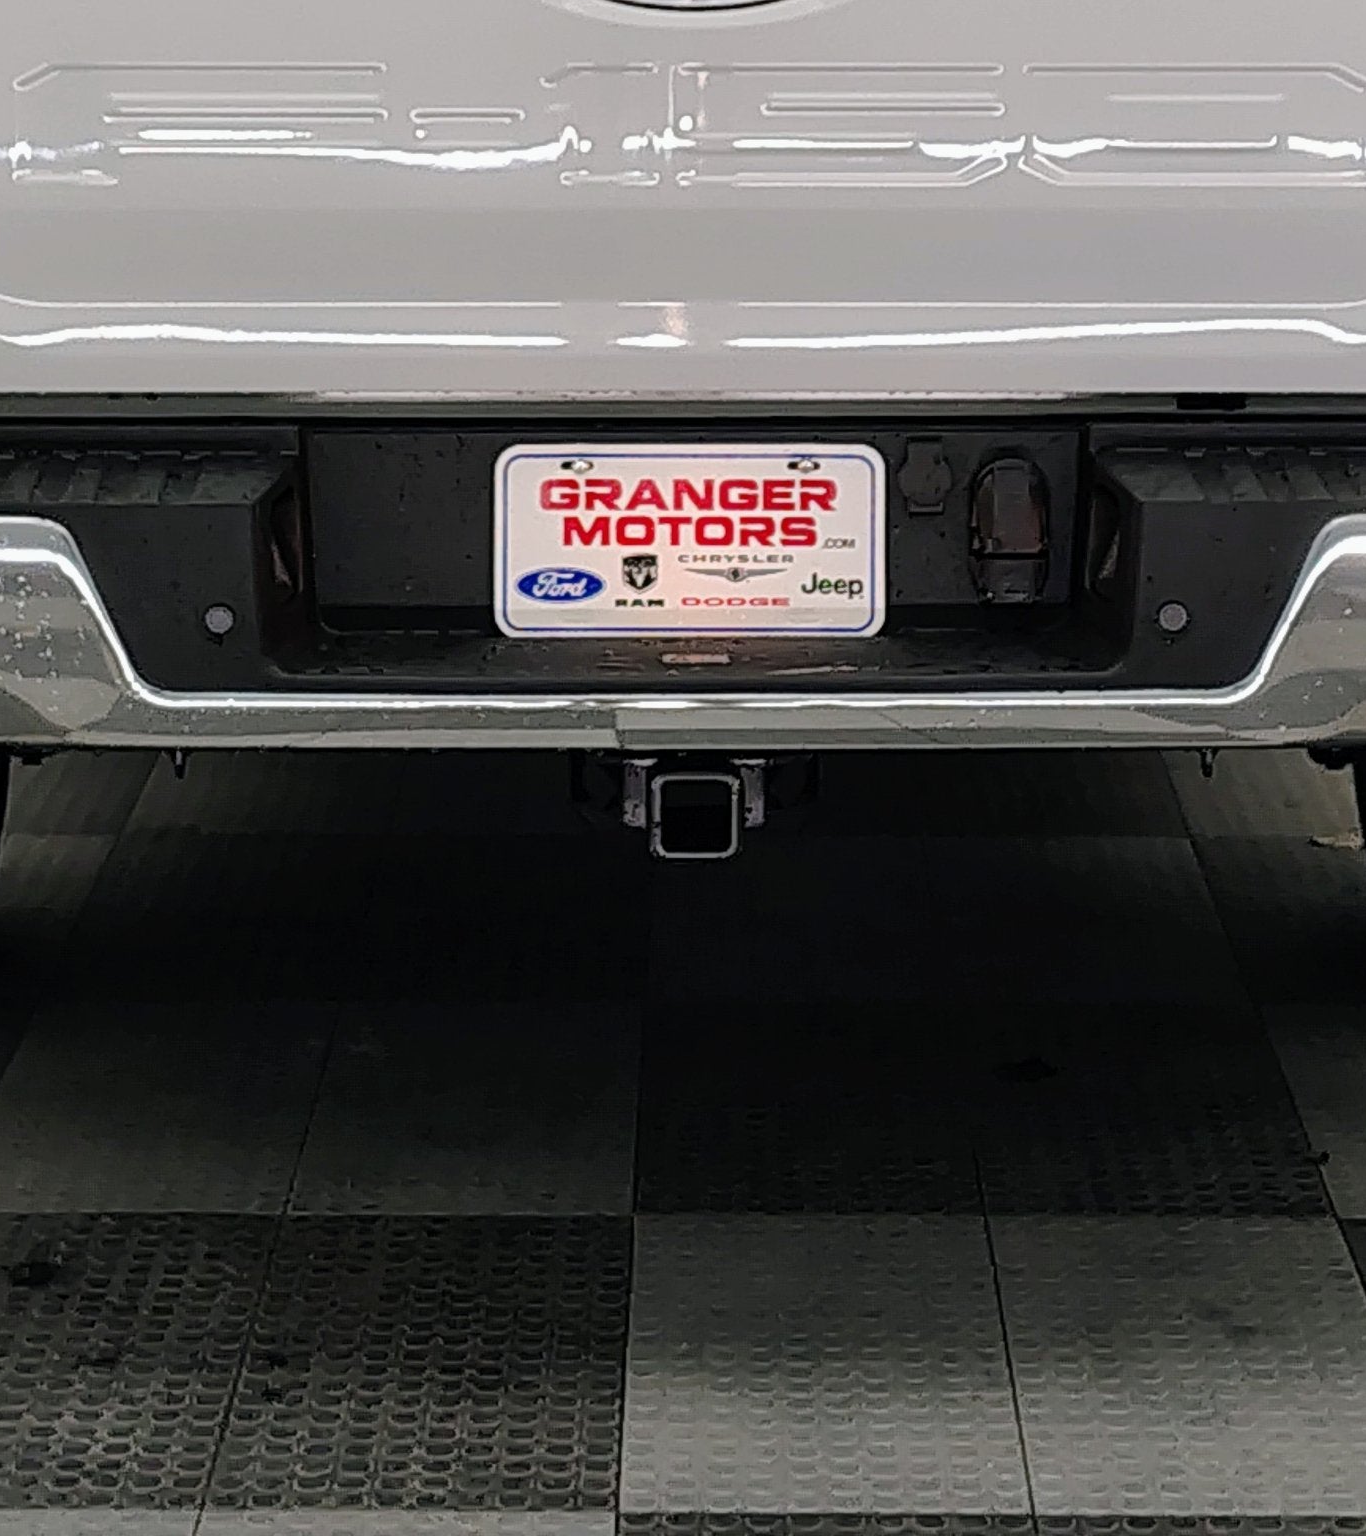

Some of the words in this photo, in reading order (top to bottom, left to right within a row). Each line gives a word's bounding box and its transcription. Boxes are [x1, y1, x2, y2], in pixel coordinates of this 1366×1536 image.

[539, 478, 837, 512] GRANGER
[561, 515, 818, 547] MOTORS
[677, 553, 795, 564] CHRYSLER
[534, 572, 587, 598] Ford
[801, 572, 865, 600] Jeep
[614, 597, 665, 608] RAM
[681, 596, 791, 608] DODGE
